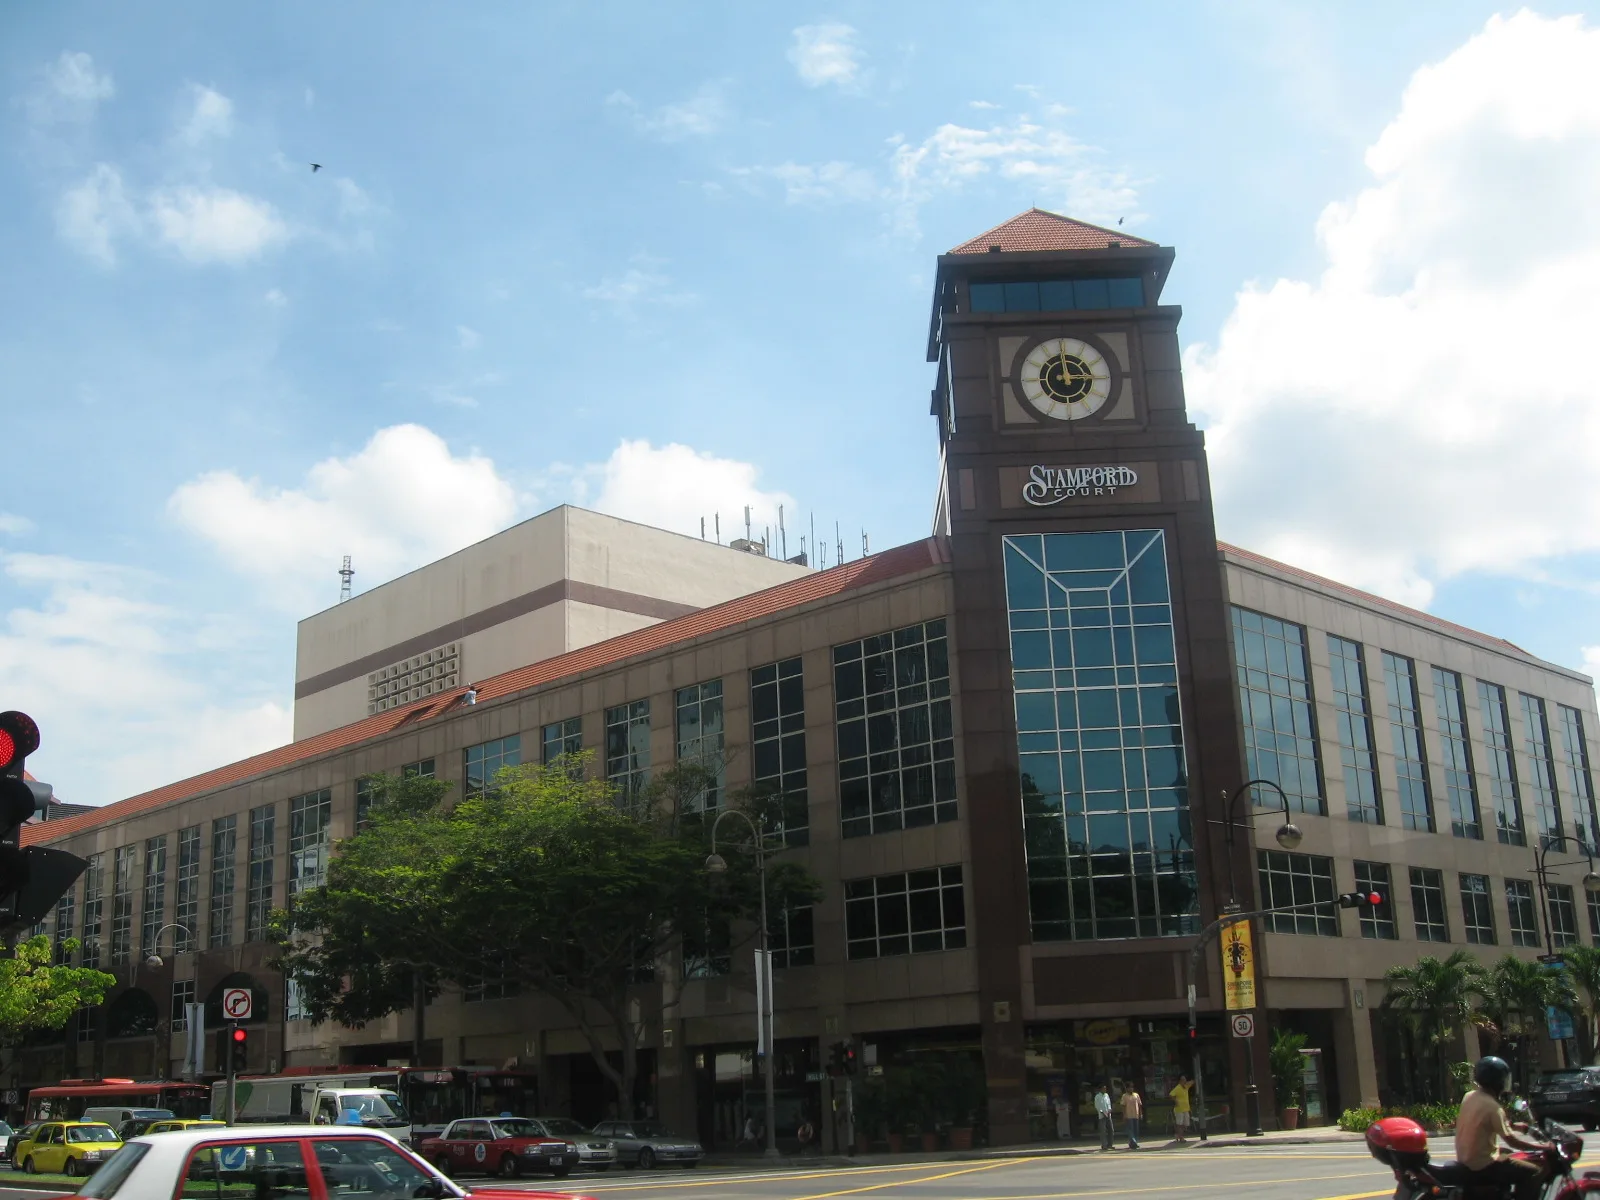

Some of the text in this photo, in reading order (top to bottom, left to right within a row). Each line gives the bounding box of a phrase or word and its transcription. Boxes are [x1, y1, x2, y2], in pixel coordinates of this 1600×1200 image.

[1023, 464, 1138, 506] STAMFORD
[1054, 486, 1117, 497] COURT
[1238, 1021, 1248, 1031] 50
